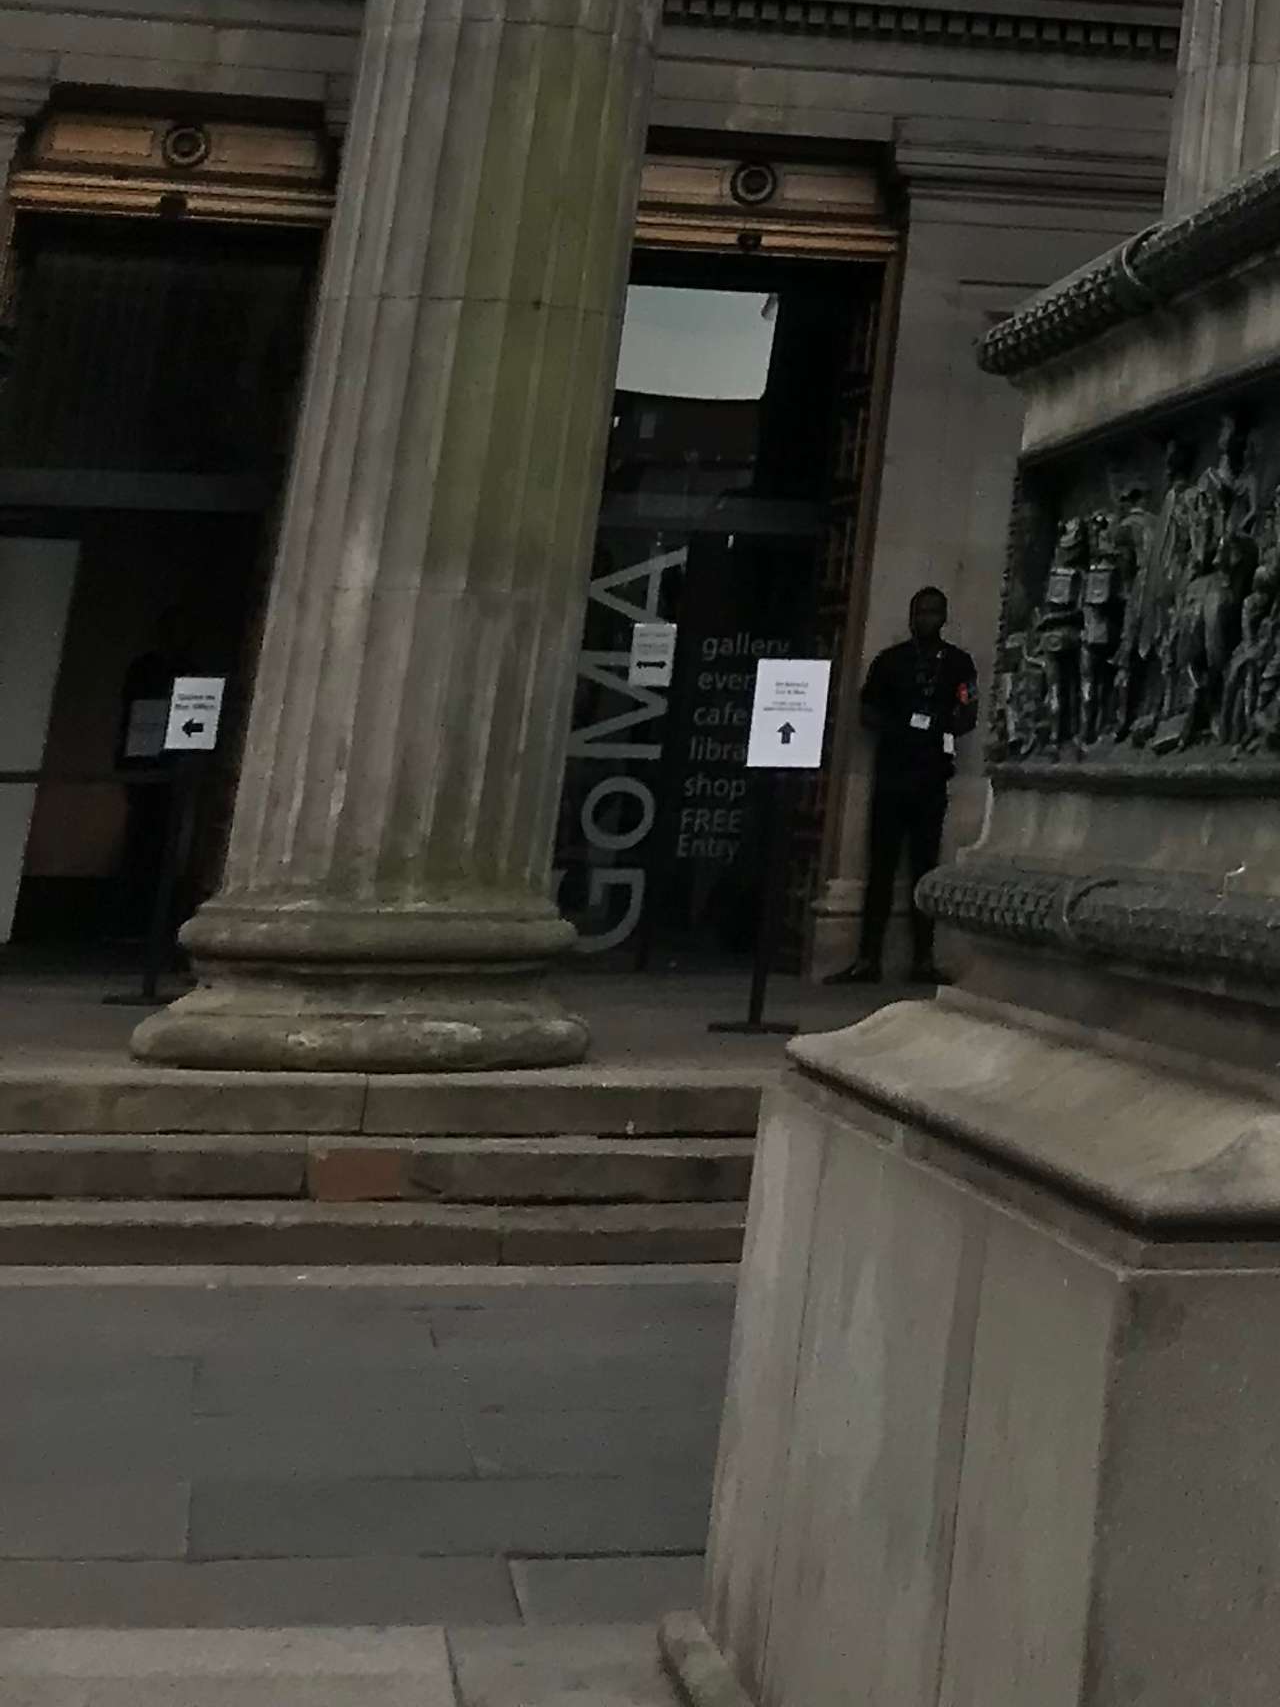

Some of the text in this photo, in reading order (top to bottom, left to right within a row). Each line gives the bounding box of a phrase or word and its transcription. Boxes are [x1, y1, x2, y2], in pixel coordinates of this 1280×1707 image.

[683, 773, 747, 800] shop
[679, 808, 743, 833] FREE
[676, 833, 739, 863] Entry
